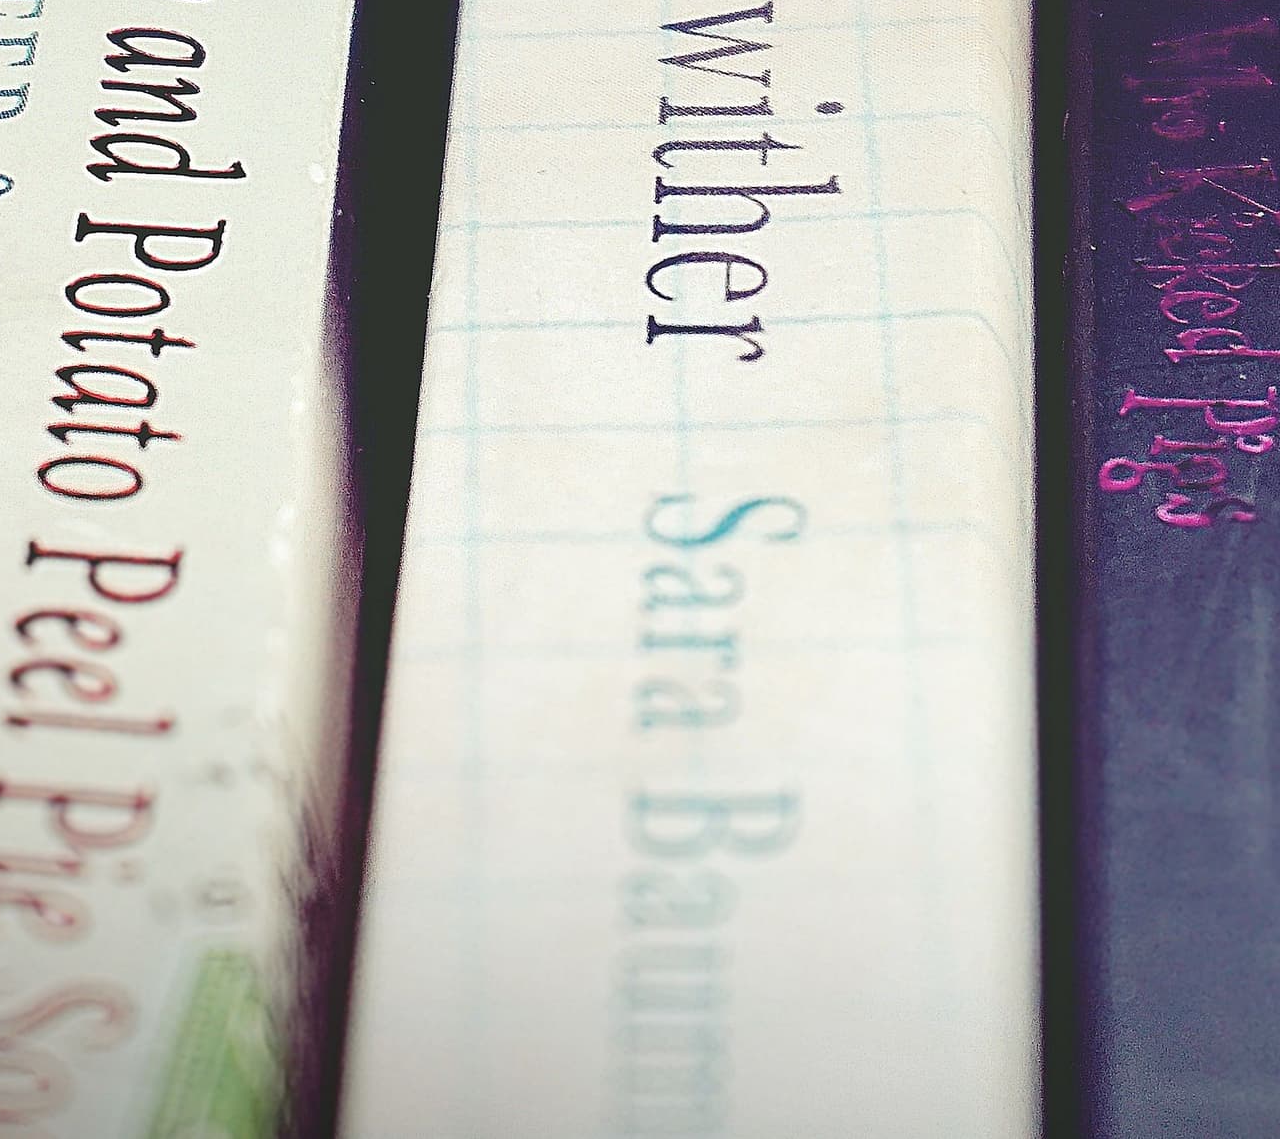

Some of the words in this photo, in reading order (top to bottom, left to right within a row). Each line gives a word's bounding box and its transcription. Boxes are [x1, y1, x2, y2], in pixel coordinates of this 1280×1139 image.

[86, 26, 247, 182] and
[645, 1, 843, 362] wither
[37, 213, 227, 501] Potato
[4, 541, 184, 736] Peel
[633, 492, 807, 733] Sara
